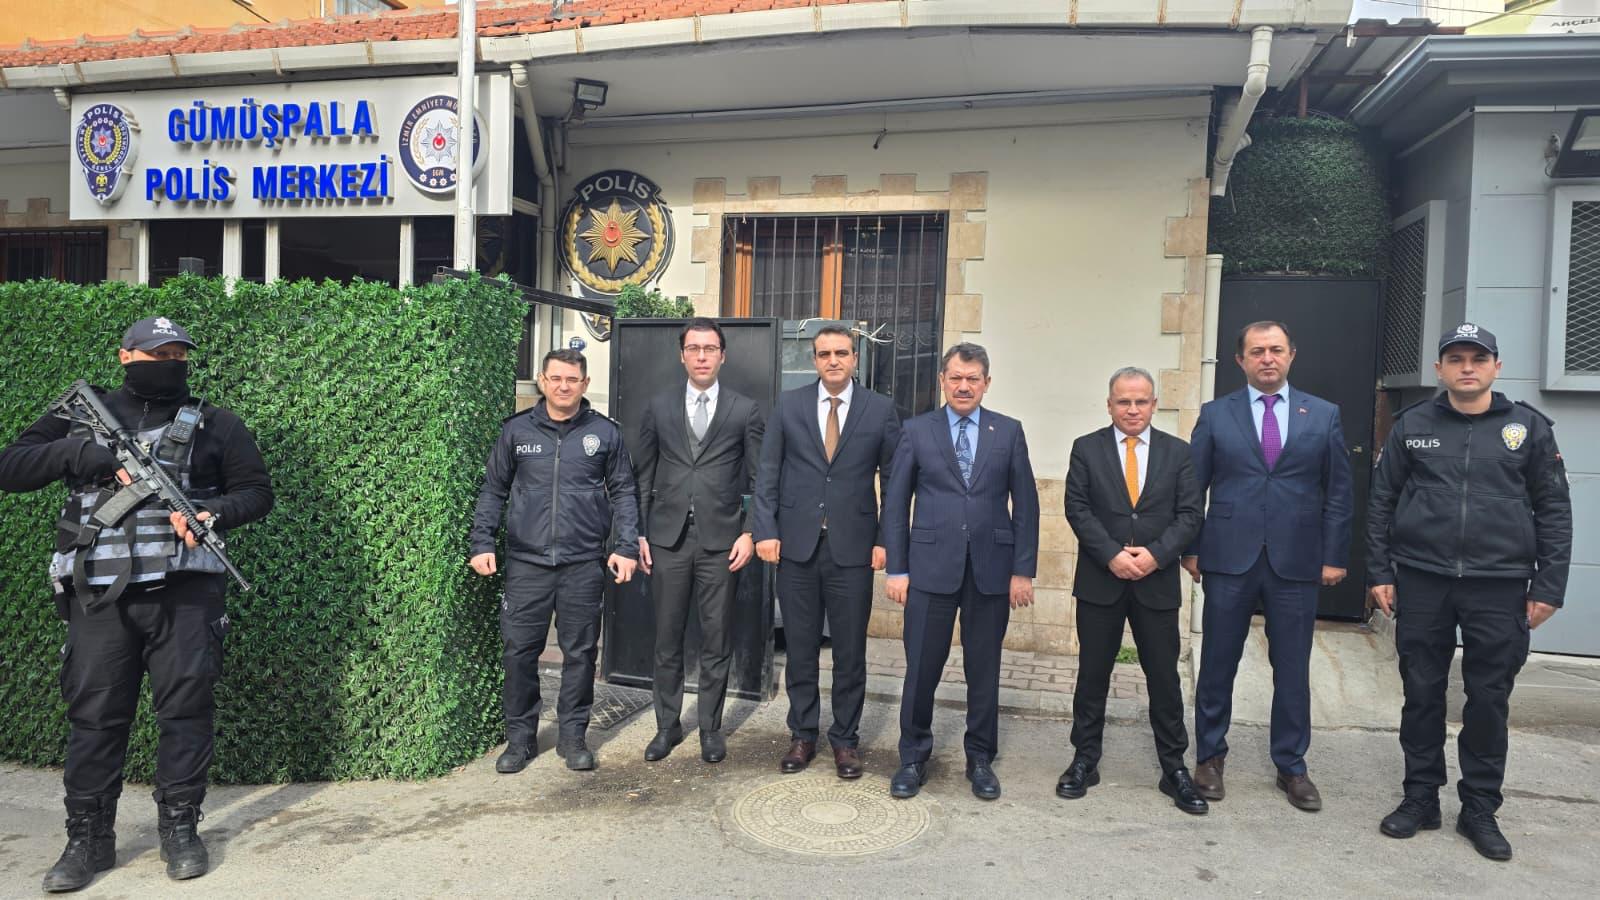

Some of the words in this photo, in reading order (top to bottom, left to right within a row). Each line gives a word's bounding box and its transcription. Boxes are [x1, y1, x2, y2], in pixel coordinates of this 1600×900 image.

[87, 106, 120, 120] POLİS
[168, 98, 373, 147] GÜMÜŞPALA
[146, 159, 230, 202] POLİS
[252, 154, 388, 200] MERKEZİ
[580, 175, 651, 201] POLİS
